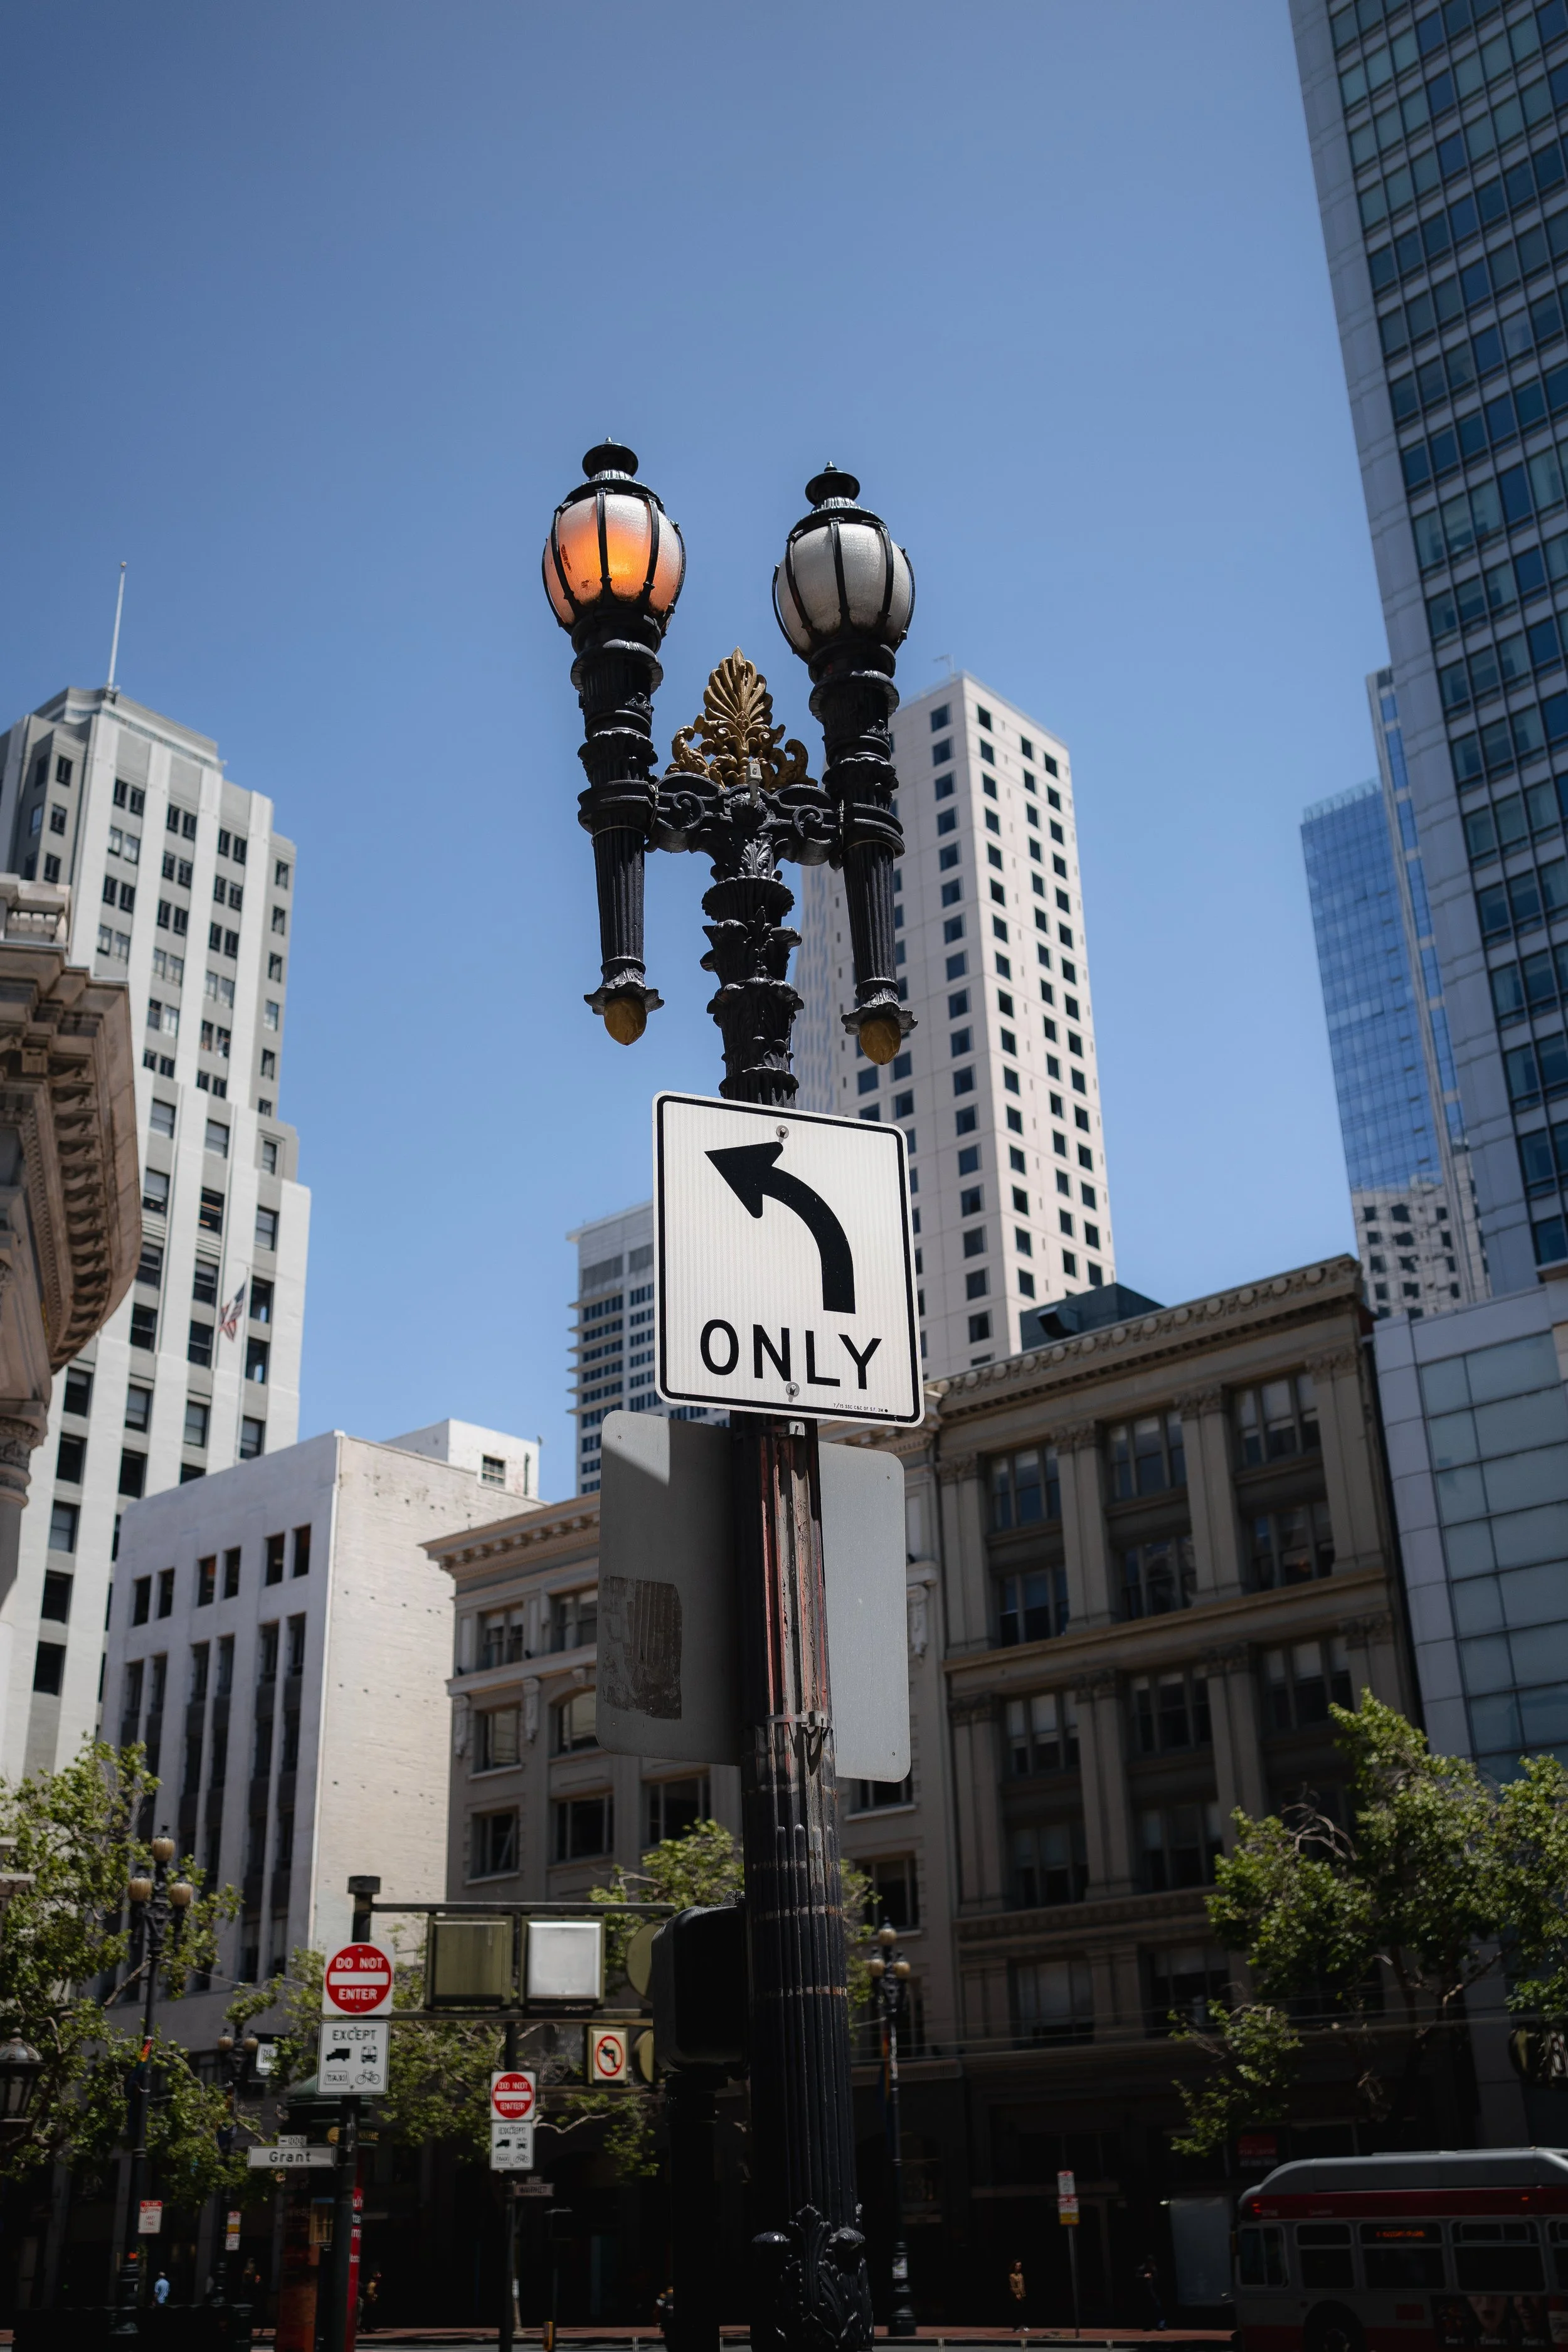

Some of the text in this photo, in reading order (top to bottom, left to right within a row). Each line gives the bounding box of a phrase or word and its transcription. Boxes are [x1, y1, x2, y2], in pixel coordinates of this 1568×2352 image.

[700, 1319, 882, 1391] ONLY
[336, 1957, 384, 1969] DO NOT
[338, 1988, 378, 2000] ENTER
[332, 2029, 377, 2040] EXCEPT
[497, 2081, 528, 2090] DO NOT
[500, 2102, 526, 2111] ENTER
[268, 2151, 312, 2163] Grant
